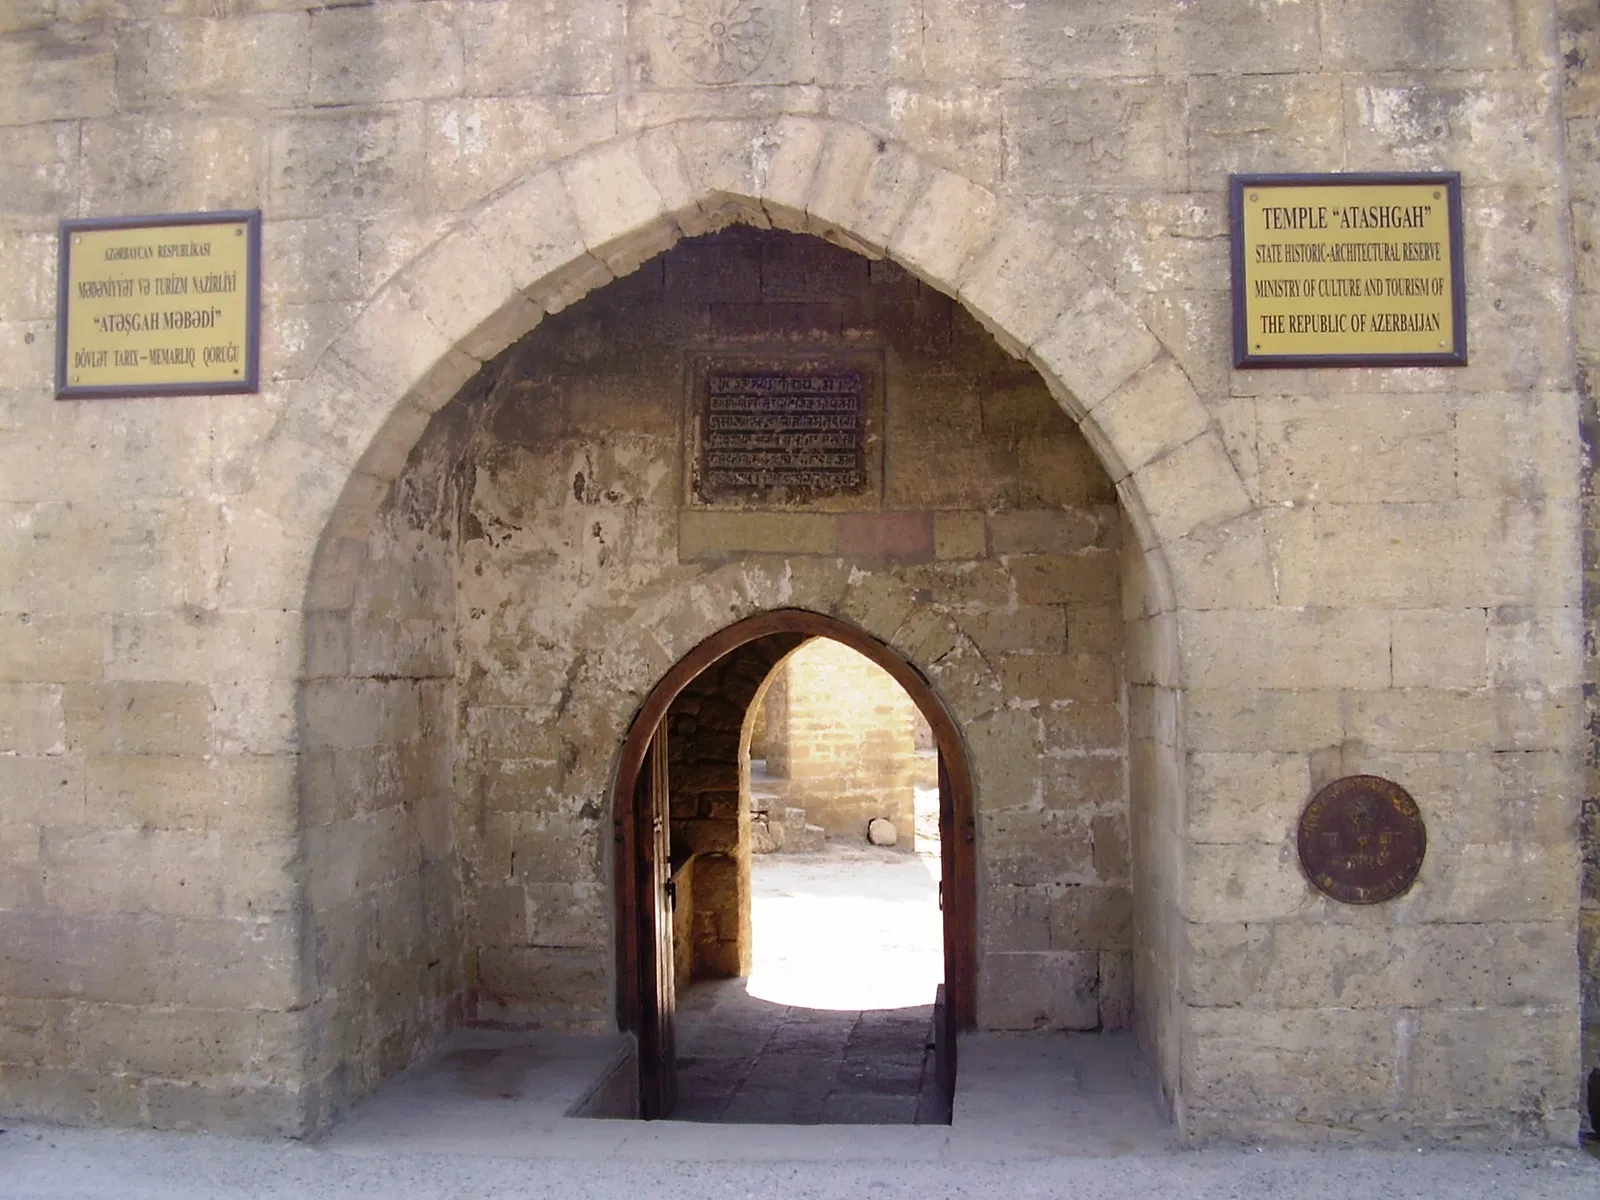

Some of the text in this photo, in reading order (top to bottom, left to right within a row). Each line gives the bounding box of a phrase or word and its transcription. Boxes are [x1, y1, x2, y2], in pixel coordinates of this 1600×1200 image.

[1263, 206, 1328, 229] TEMPLE
[1255, 243, 1283, 263] STATE
[1402, 242, 1442, 262] RESERVE
[1255, 277, 1444, 299] MINISTRY OF CULTURE AND TOURISM OF
[1260, 312, 1440, 334] THE REPUBLIC OF AZERBAIJAN
